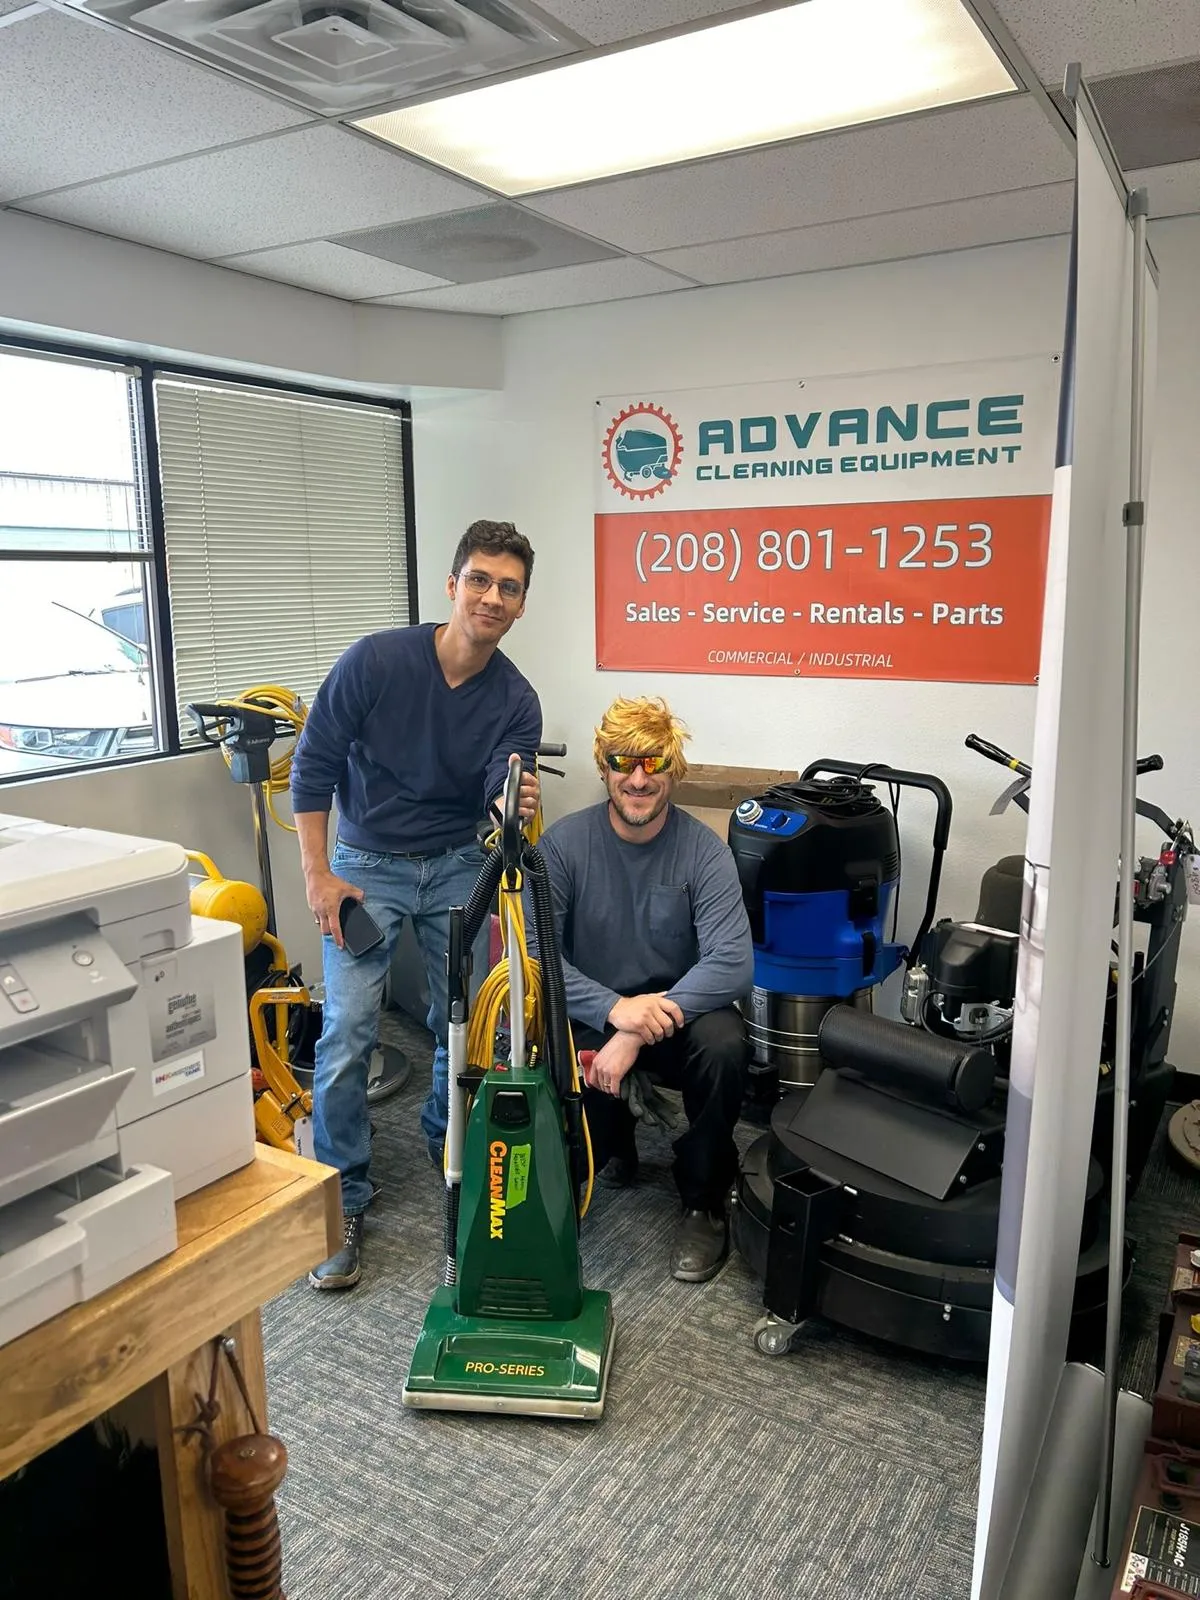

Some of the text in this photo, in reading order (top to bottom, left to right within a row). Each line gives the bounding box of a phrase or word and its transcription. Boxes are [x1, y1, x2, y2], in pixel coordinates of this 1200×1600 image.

[699, 394, 1025, 456] ADVANCE
[696, 445, 1022, 481] CLEANING EQUIPMENT
[635, 523, 993, 582] (208) 801-1253
[626, 602, 681, 623] Sales
[703, 601, 786, 624] Service
[810, 601, 905, 625] Rentals
[932, 603, 1004, 625] Parts
[708, 650, 894, 668] COMMERCIAL / INDUSTRIAL
[465, 1361, 545, 1377] PRO-SERIES
[1173, 1522, 1191, 1568] J185H-AC
